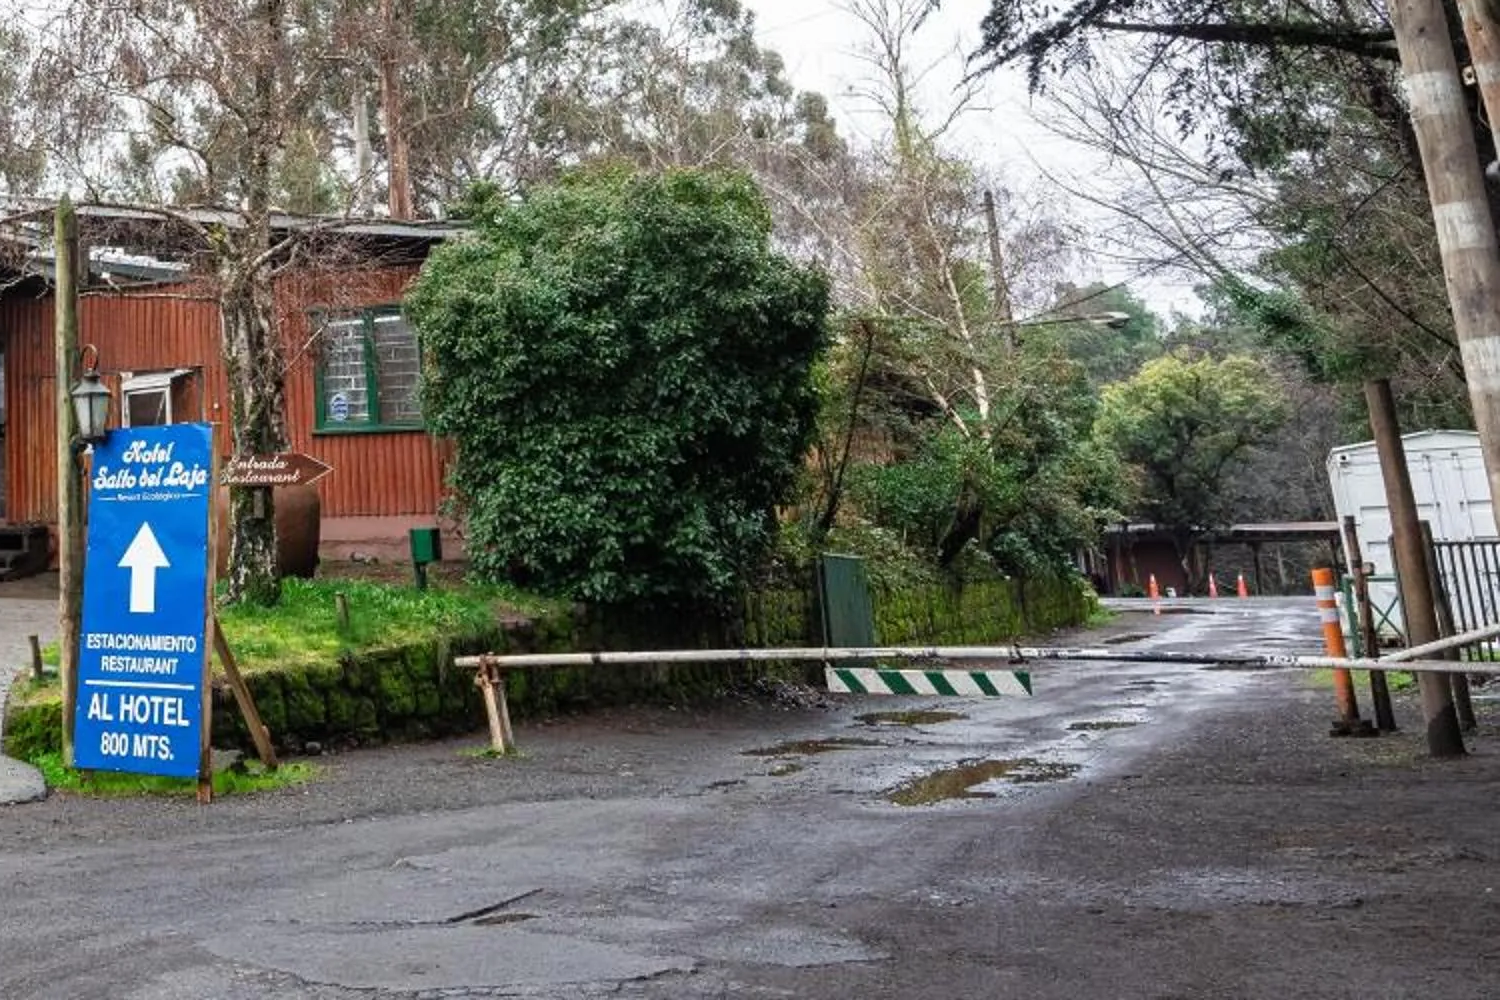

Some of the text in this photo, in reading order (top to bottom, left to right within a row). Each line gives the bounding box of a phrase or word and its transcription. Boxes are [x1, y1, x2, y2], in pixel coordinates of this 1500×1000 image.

[122, 440, 174, 463] Hotel
[228, 455, 288, 470] Entrada
[94, 461, 207, 490] Salto del Laja
[86, 633, 197, 653] ESTACIONAMIENTO
[100, 655, 179, 675] RESTAURANT
[87, 692, 191, 727] AL HOTEL
[100, 731, 175, 761] 800 MTS.
